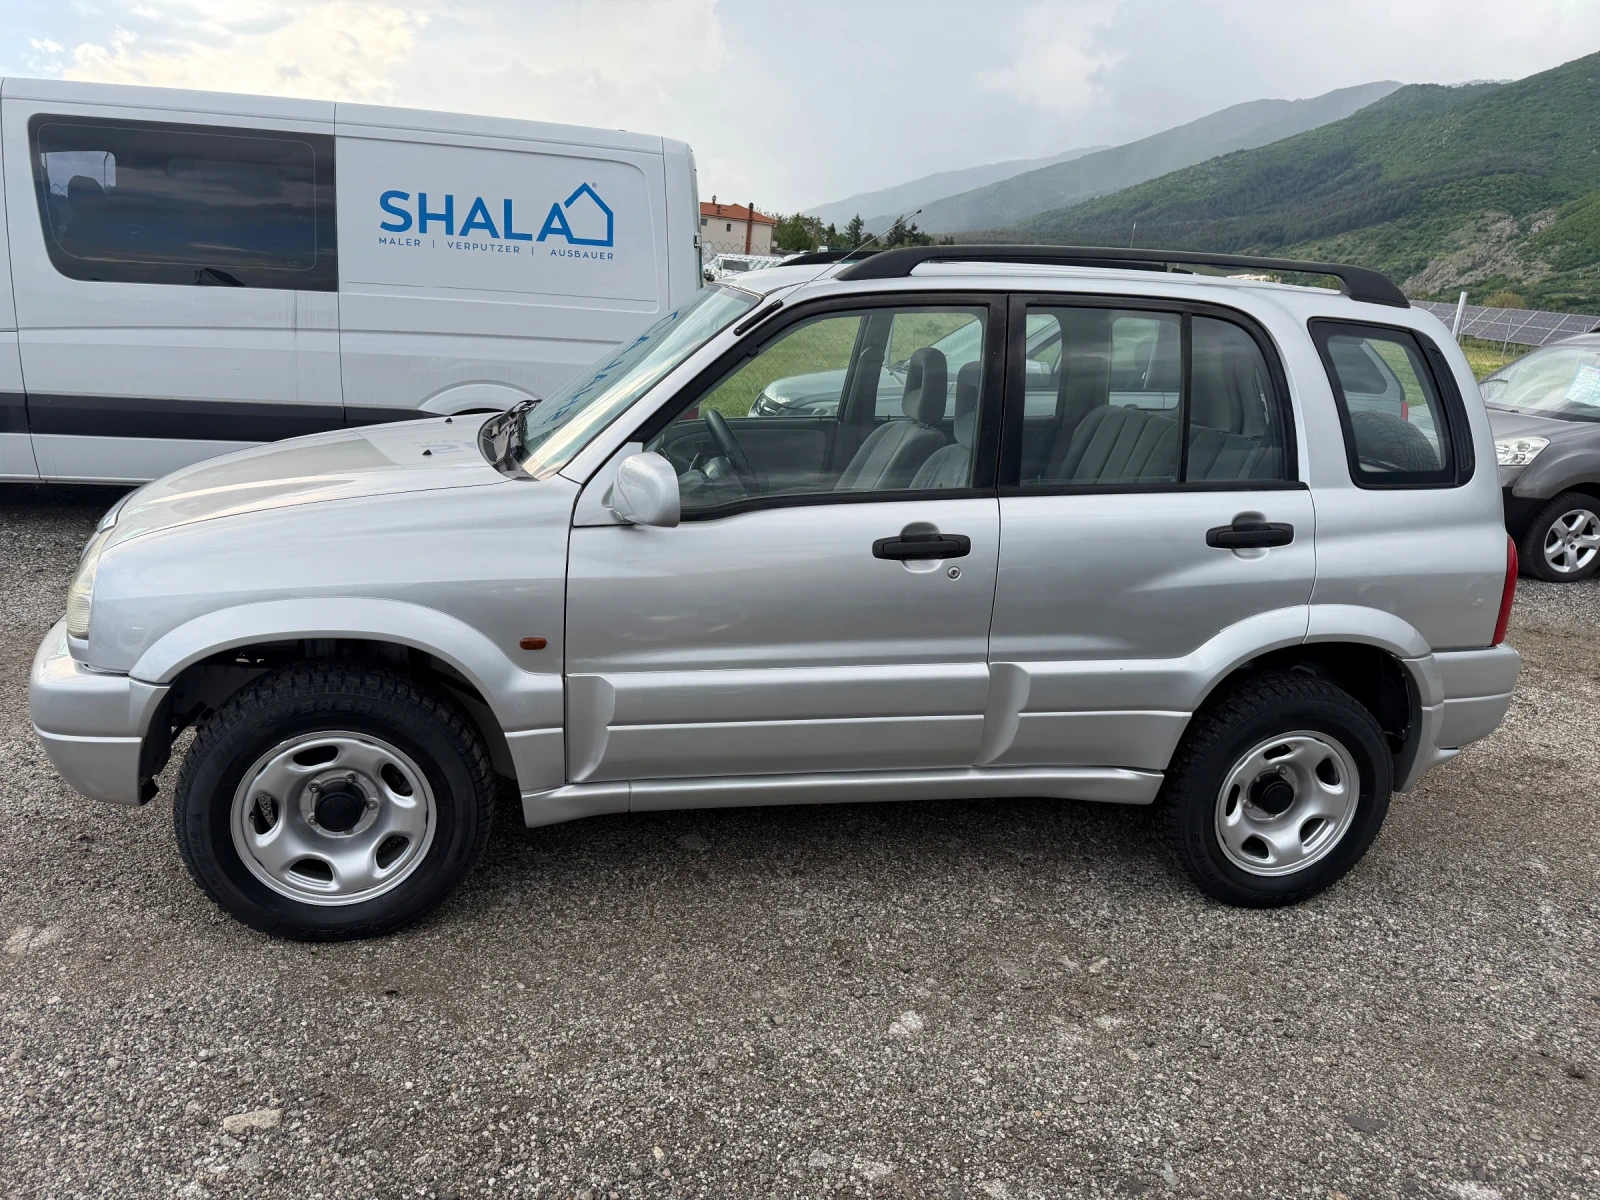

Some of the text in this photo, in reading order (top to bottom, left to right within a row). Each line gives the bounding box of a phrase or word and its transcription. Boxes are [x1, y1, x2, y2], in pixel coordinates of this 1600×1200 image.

[379, 190, 576, 244] SHALA
[379, 236, 614, 261] MALER VERPUTZER AUSBAUER
